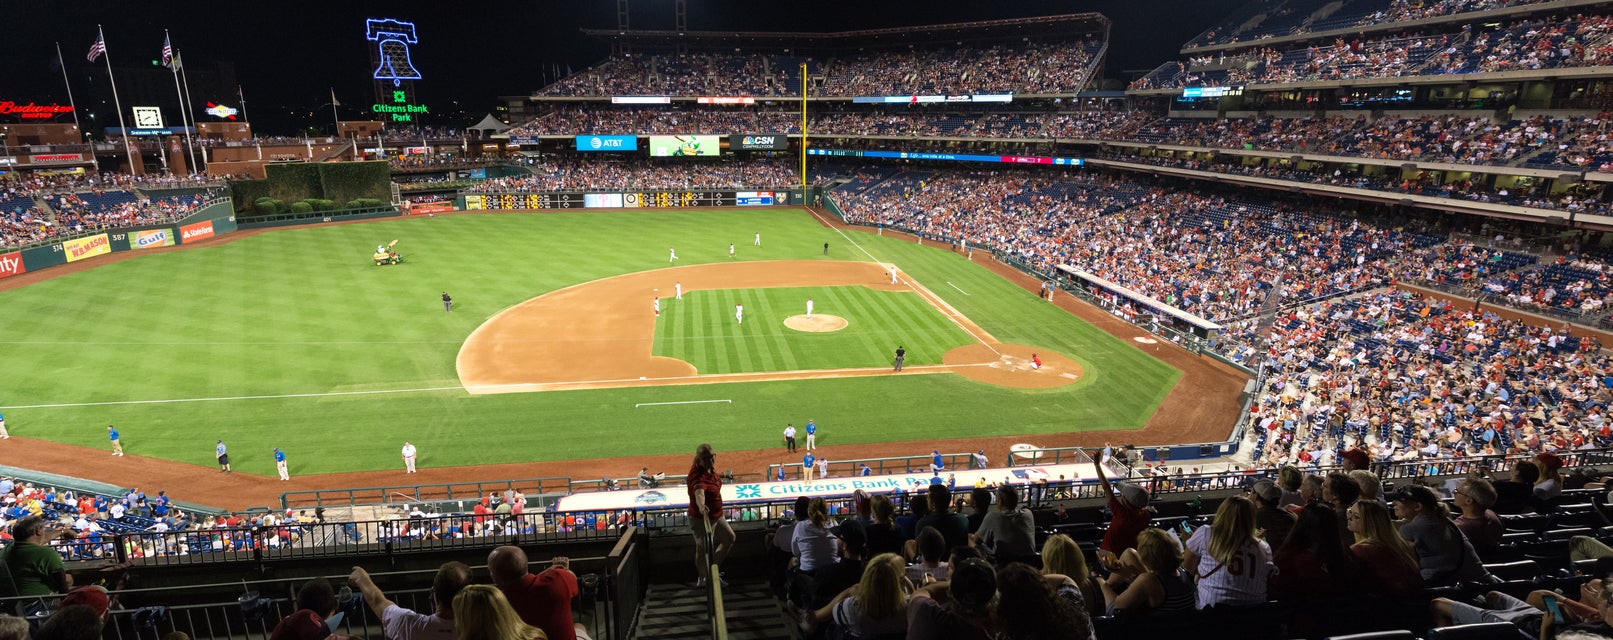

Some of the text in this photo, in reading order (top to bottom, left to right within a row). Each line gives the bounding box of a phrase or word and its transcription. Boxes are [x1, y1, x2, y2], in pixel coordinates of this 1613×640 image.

[0, 101, 75, 114] Budweiser
[373, 104, 428, 113] Citizens Bank
[392, 113, 411, 122] Park
[755, 136, 775, 144] CSN
[138, 232, 166, 246] Gulf
[52, 244, 64, 252] 374
[769, 482, 847, 495] Citizens
[852, 478, 900, 490] Bank
